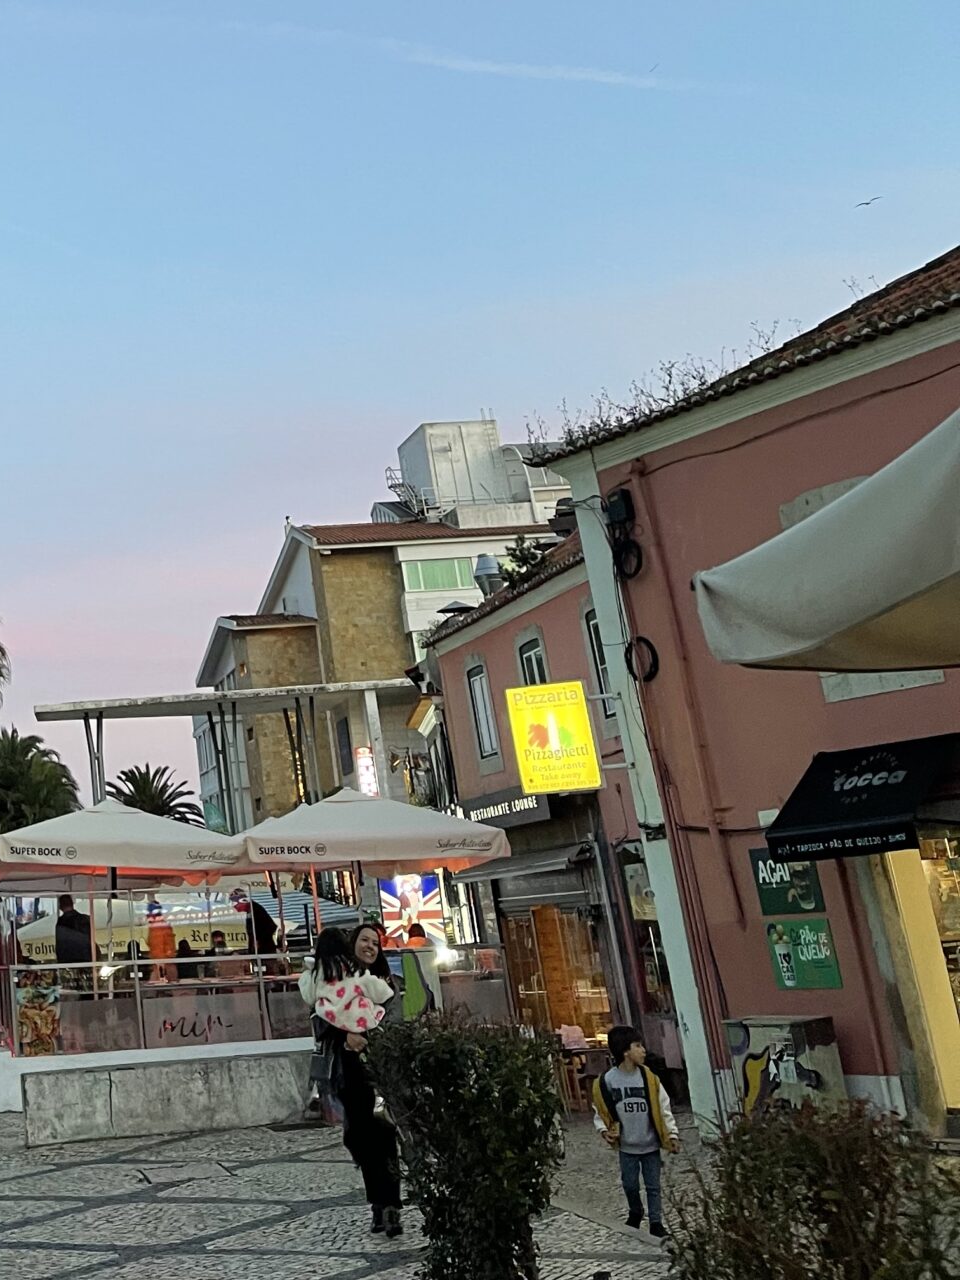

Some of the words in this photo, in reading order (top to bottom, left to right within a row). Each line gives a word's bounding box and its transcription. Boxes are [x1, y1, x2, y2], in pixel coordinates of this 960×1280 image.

[513, 687, 579, 707] Pizzaria
[523, 743, 589, 762] Pizzaghetti
[470, 801, 510, 822] RESTAURANTE
[511, 795, 538, 813] LOUNGE
[10, 846, 37, 856] SUPER
[38, 847, 61, 857] BOCK
[258, 846, 286, 855] SUPER
[287, 845, 311, 855] BOCK
[798, 944, 830, 961] QUEIJO
[624, 1101, 647, 1113] 1970
